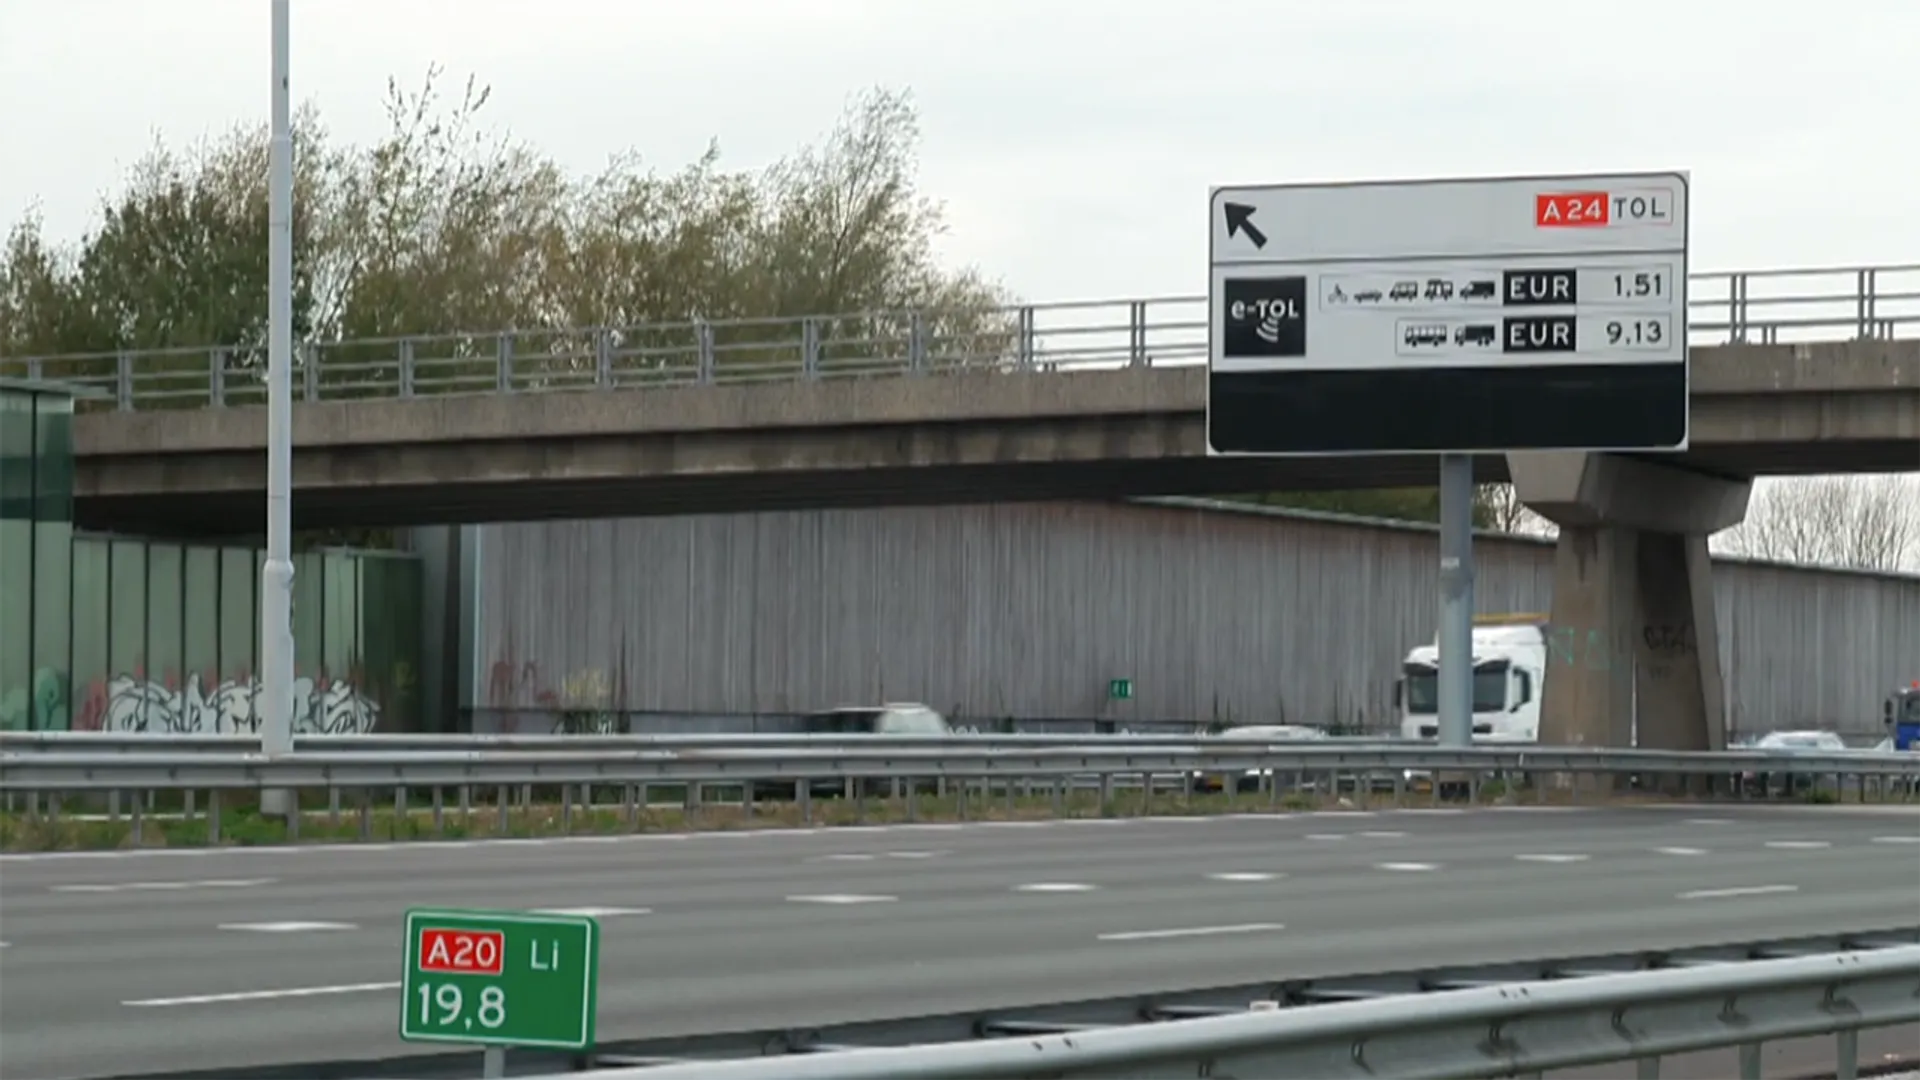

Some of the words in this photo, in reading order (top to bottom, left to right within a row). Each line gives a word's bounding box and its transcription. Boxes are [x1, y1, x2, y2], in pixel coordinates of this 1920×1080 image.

[1543, 199, 1602, 222] A24
[1614, 197, 1665, 218] TOL
[1510, 276, 1569, 299] EUR
[1614, 273, 1661, 298] 1,51
[1231, 299, 1299, 319] e-TOL
[1510, 323, 1569, 346] EUR
[1606, 321, 1662, 345] 9,13
[428, 935, 496, 967] A20
[531, 939, 559, 971] Li
[418, 983, 505, 1031] 19,8
